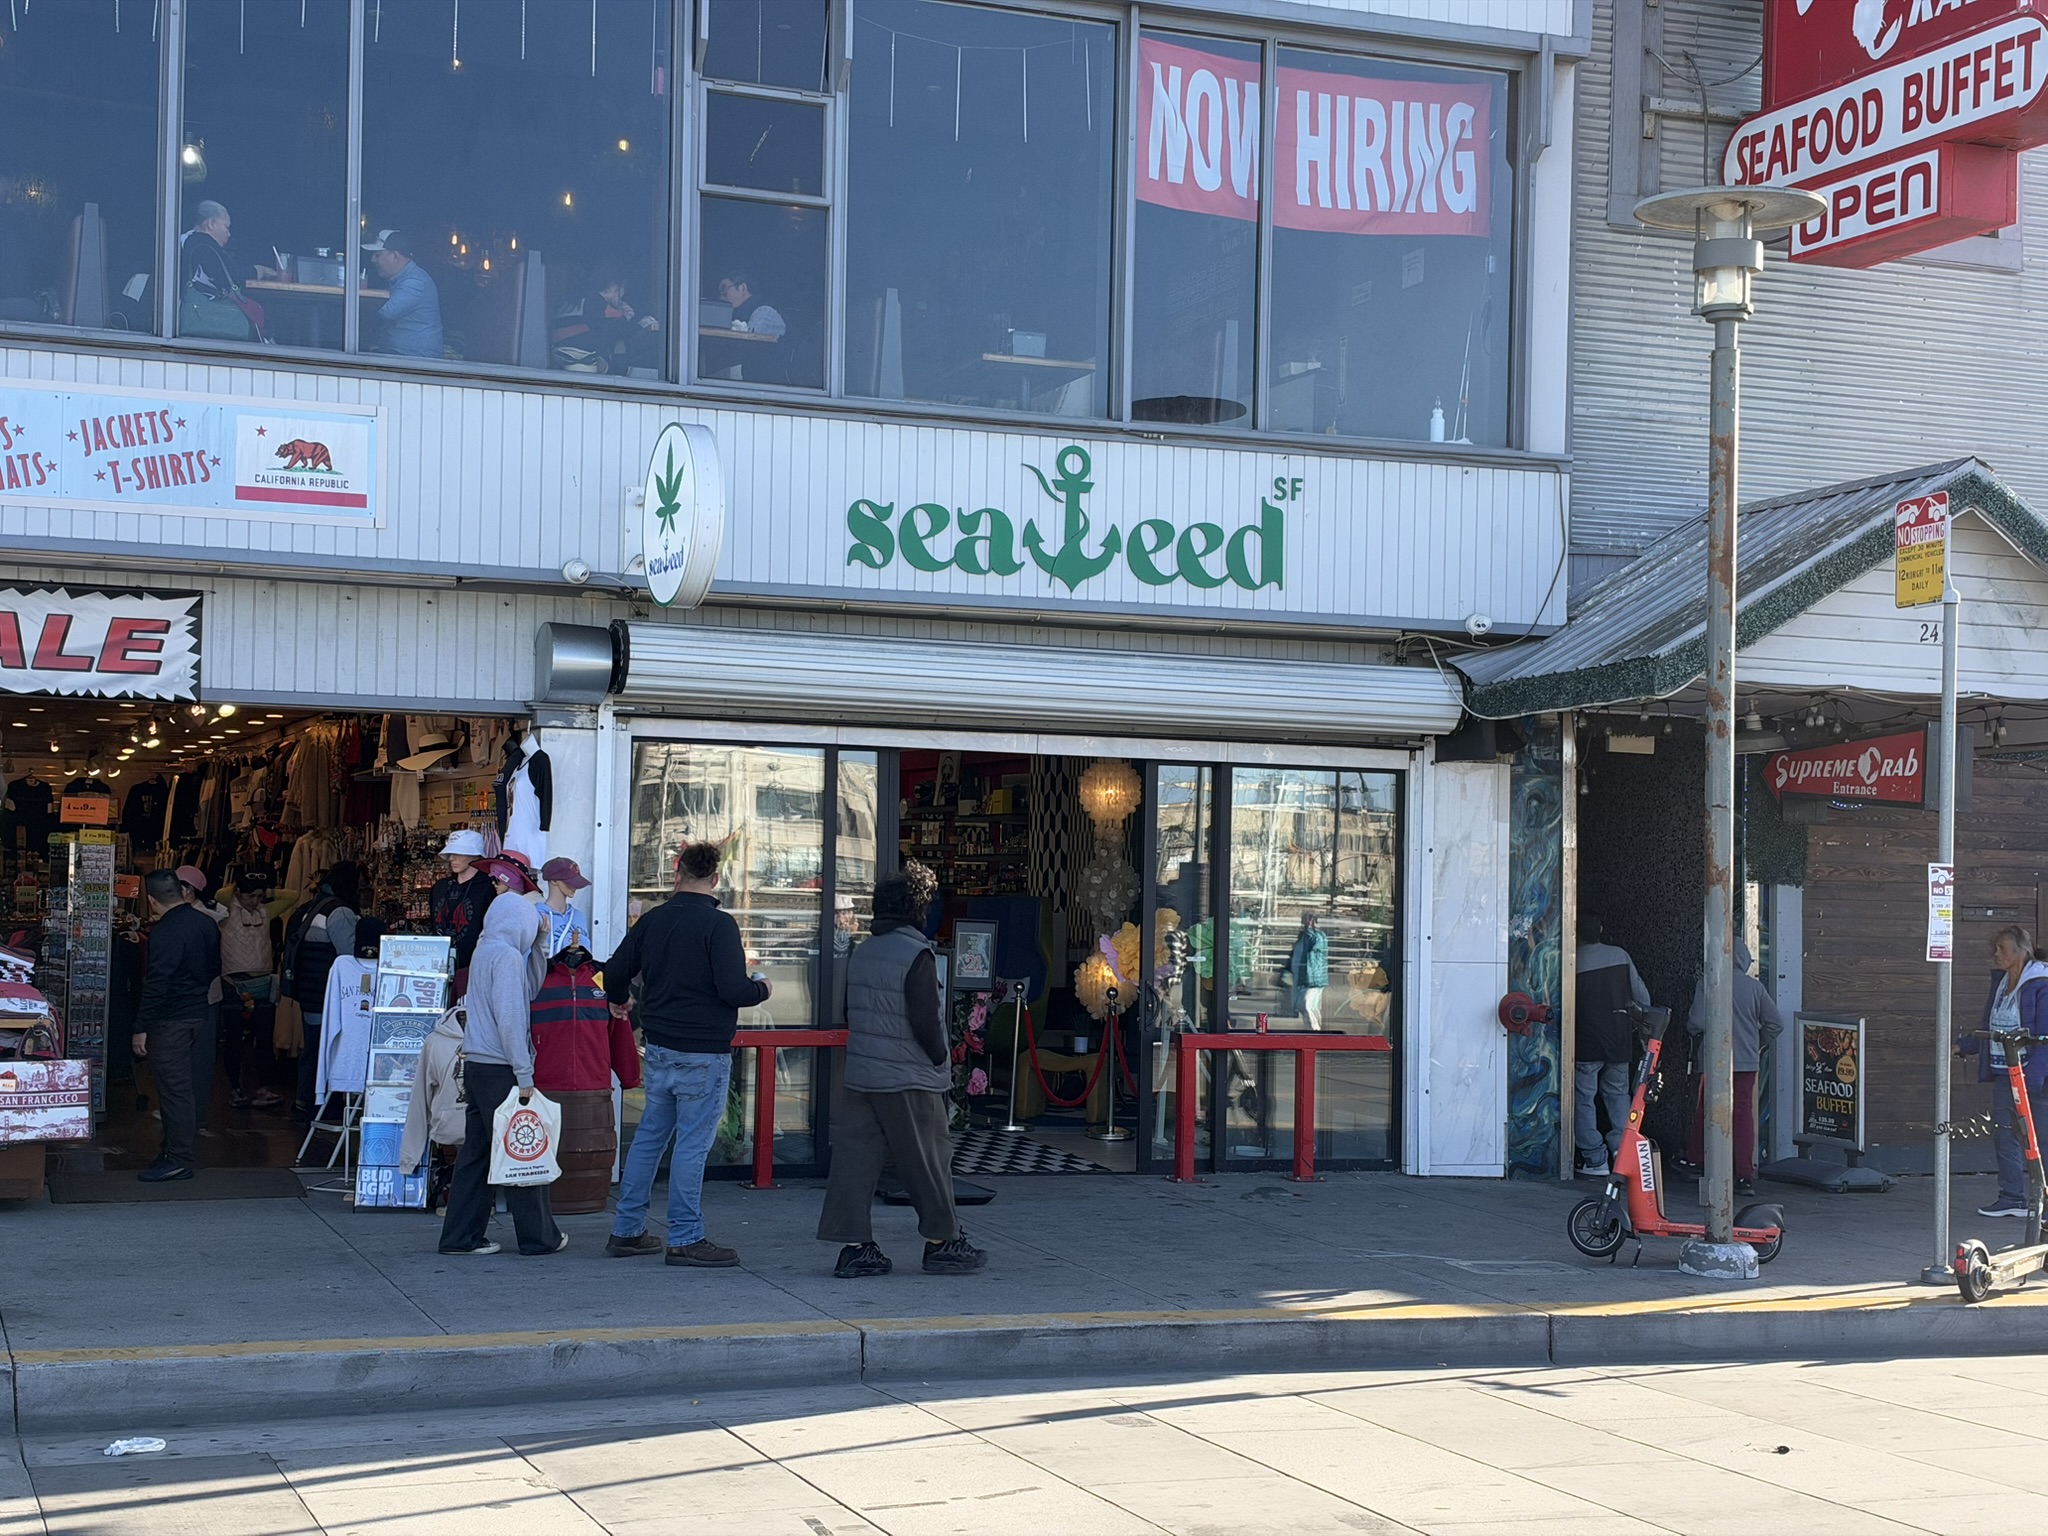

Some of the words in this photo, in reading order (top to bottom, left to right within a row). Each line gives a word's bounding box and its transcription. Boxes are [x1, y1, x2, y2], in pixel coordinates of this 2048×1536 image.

[1734, 87, 1884, 186] SEAFOOD
[1902, 27, 2042, 134] BUFFET
[1149, 61, 1280, 200] NOW
[1296, 89, 1477, 215] HIRING
[80, 409, 174, 457] JACKETS
[0, 451, 47, 491] ATS
[107, 449, 211, 494] T-SHIRTS
[254, 474, 306, 487] CALIFORNIA
[309, 477, 350, 490] REPUBLIC
[1273, 476, 1304, 502] SF
[1898, 526, 1911, 546] NO
[1912, 522, 1945, 544] STOPPING
[1898, 553, 1923, 563] COMMERCIAL
[1899, 546, 1916, 554] EXCEPT
[1911, 581, 1929, 591] DAILY
[1920, 623, 1943, 643] 24
[1832, 781, 1877, 795] Entrance
[413, 980, 437, 1008] SPO
[1805, 1078, 1854, 1098] SEAFOOD
[22, 1094, 79, 1105] FRANCISCO
[1816, 1096, 1855, 1115] BUFFET
[509, 1139, 543, 1154] CENTRAL
[361, 1169, 393, 1182] BUD
[1638, 1143, 1652, 1189] NYWIW
